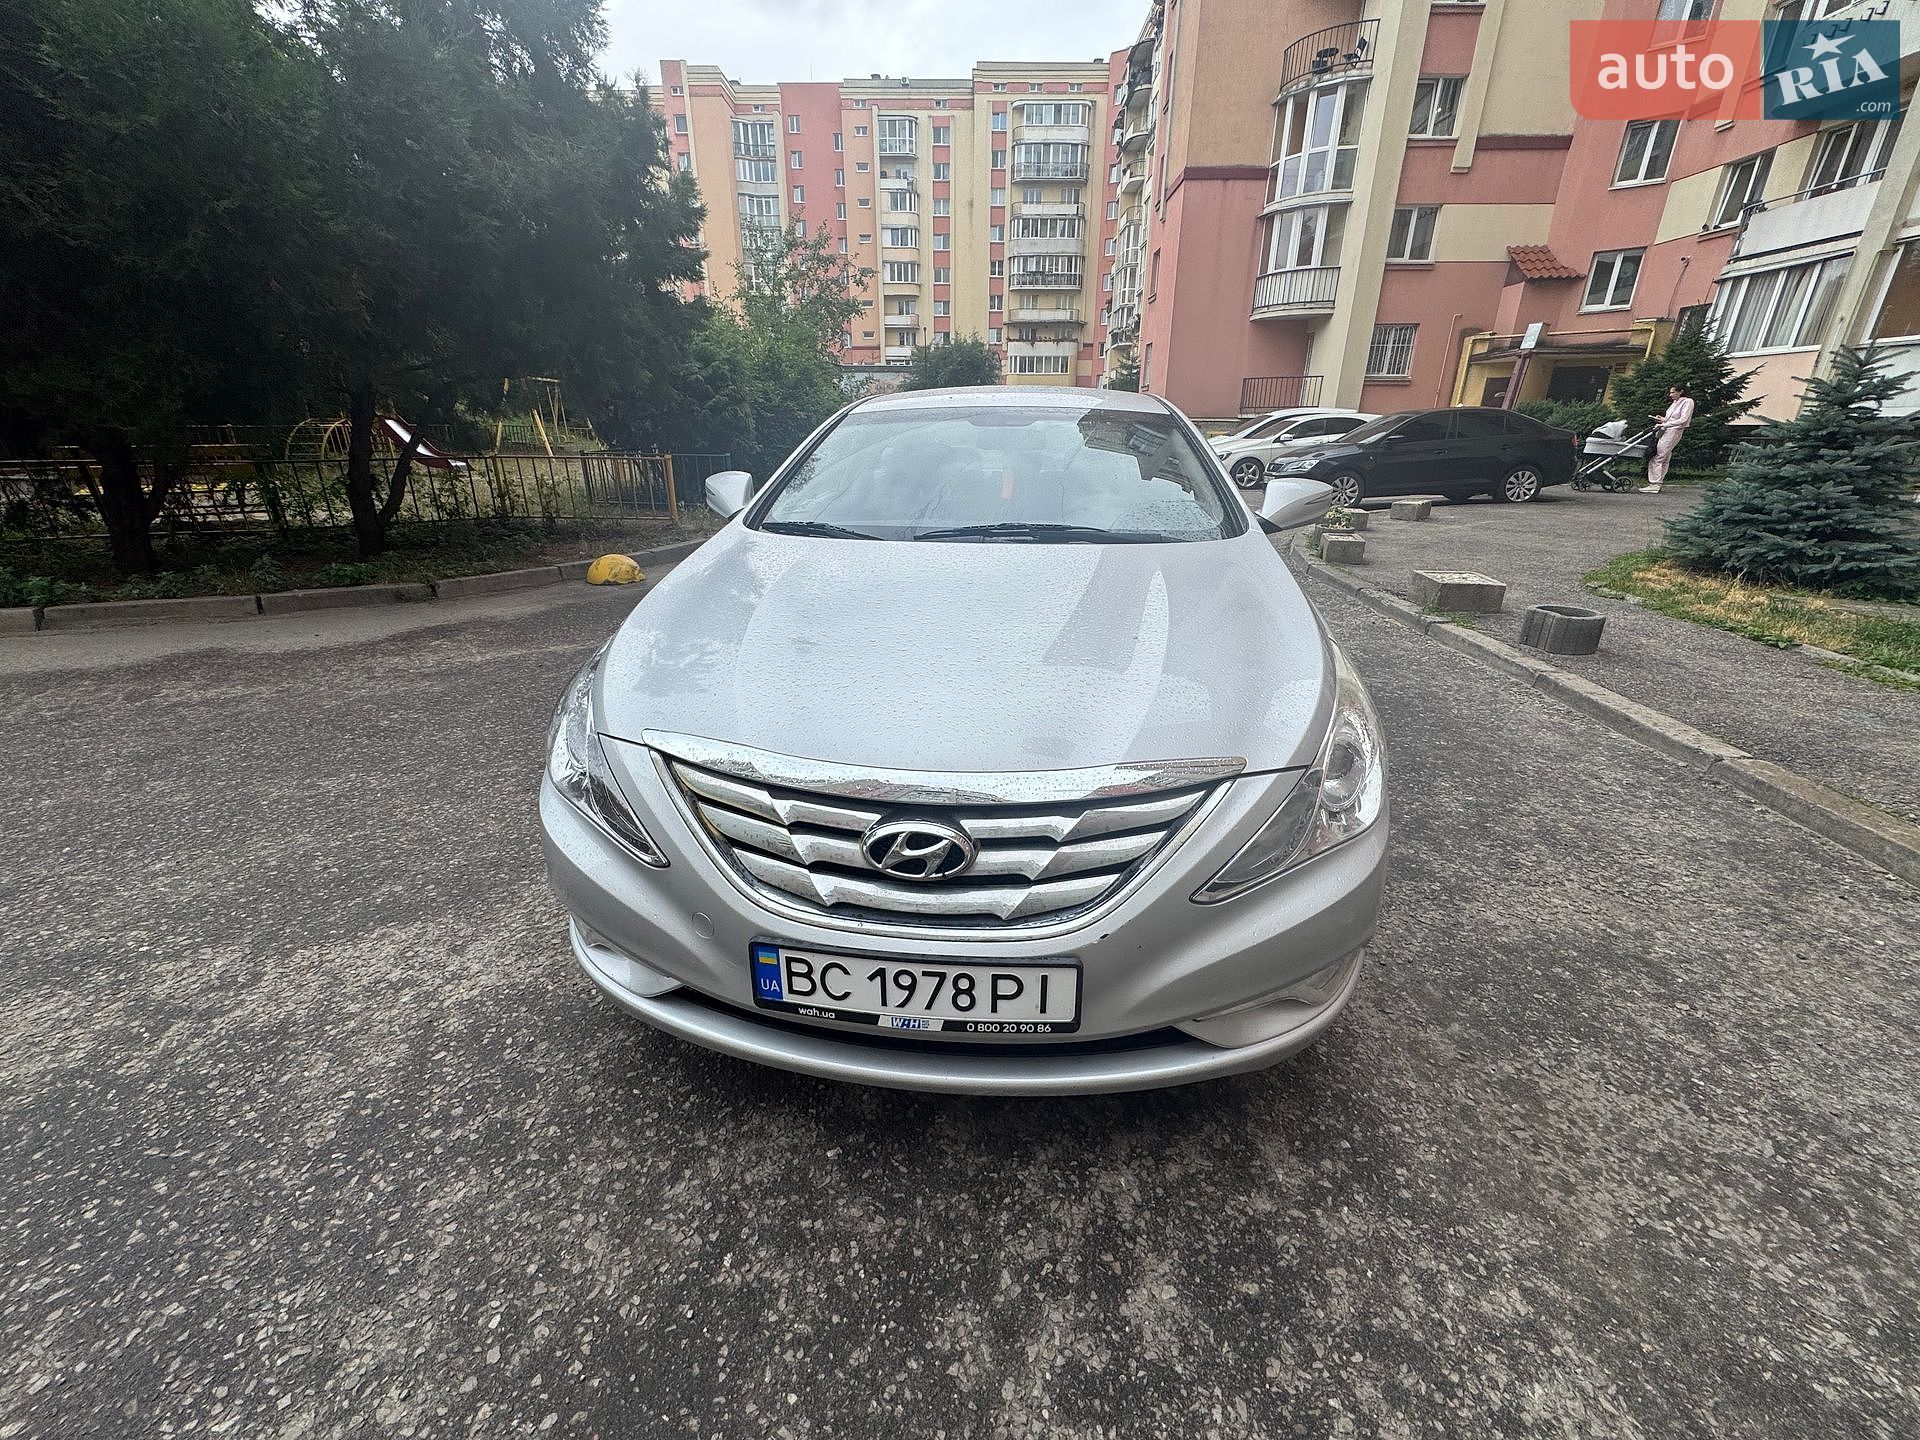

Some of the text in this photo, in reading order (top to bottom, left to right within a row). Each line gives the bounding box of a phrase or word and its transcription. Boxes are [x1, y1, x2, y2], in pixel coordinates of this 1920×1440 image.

[760, 977, 780, 992] UA
[785, 955, 1048, 1014] BC 1978 PI
[798, 1007, 836, 1019] wah.ua
[977, 1023, 1000, 1032] 800
[1002, 1024, 1017, 1032] 20
[1019, 1024, 1035, 1033] 90
[1036, 1024, 1052, 1033] 86
